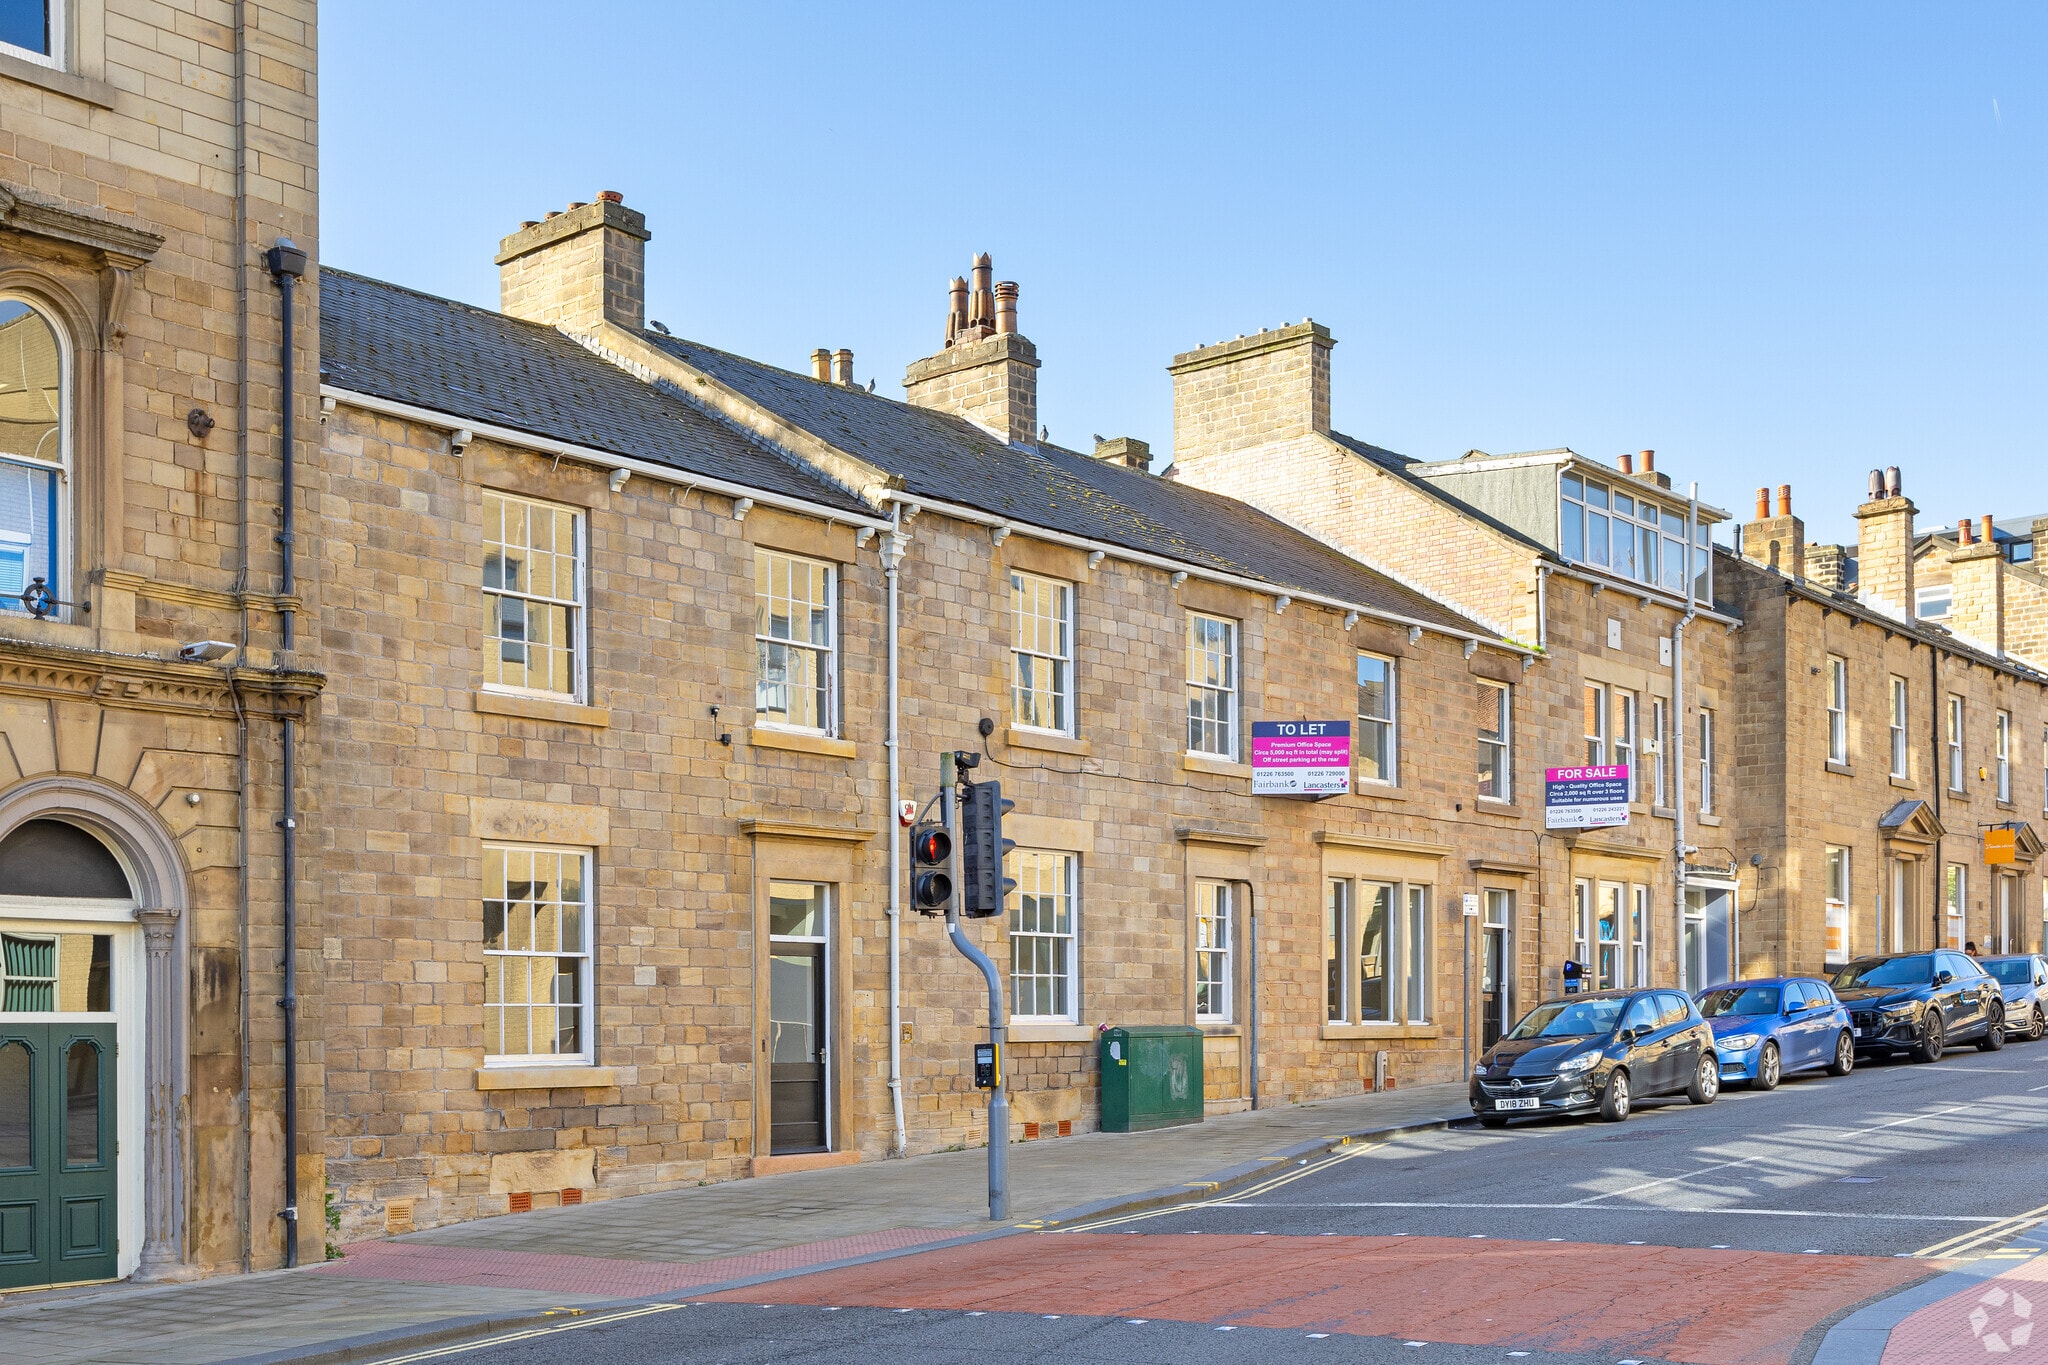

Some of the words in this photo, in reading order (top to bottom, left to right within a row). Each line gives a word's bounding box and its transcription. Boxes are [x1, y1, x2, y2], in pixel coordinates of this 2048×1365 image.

[1277, 724, 1296, 735] TO
[1300, 724, 1326, 735] LET
[1558, 770, 1582, 779] FOR
[1585, 768, 1616, 778] SALE
[1254, 780, 1289, 788] Fairbank
[1500, 1100, 1516, 1108] DY18
[1519, 1099, 1534, 1107] ZHU
